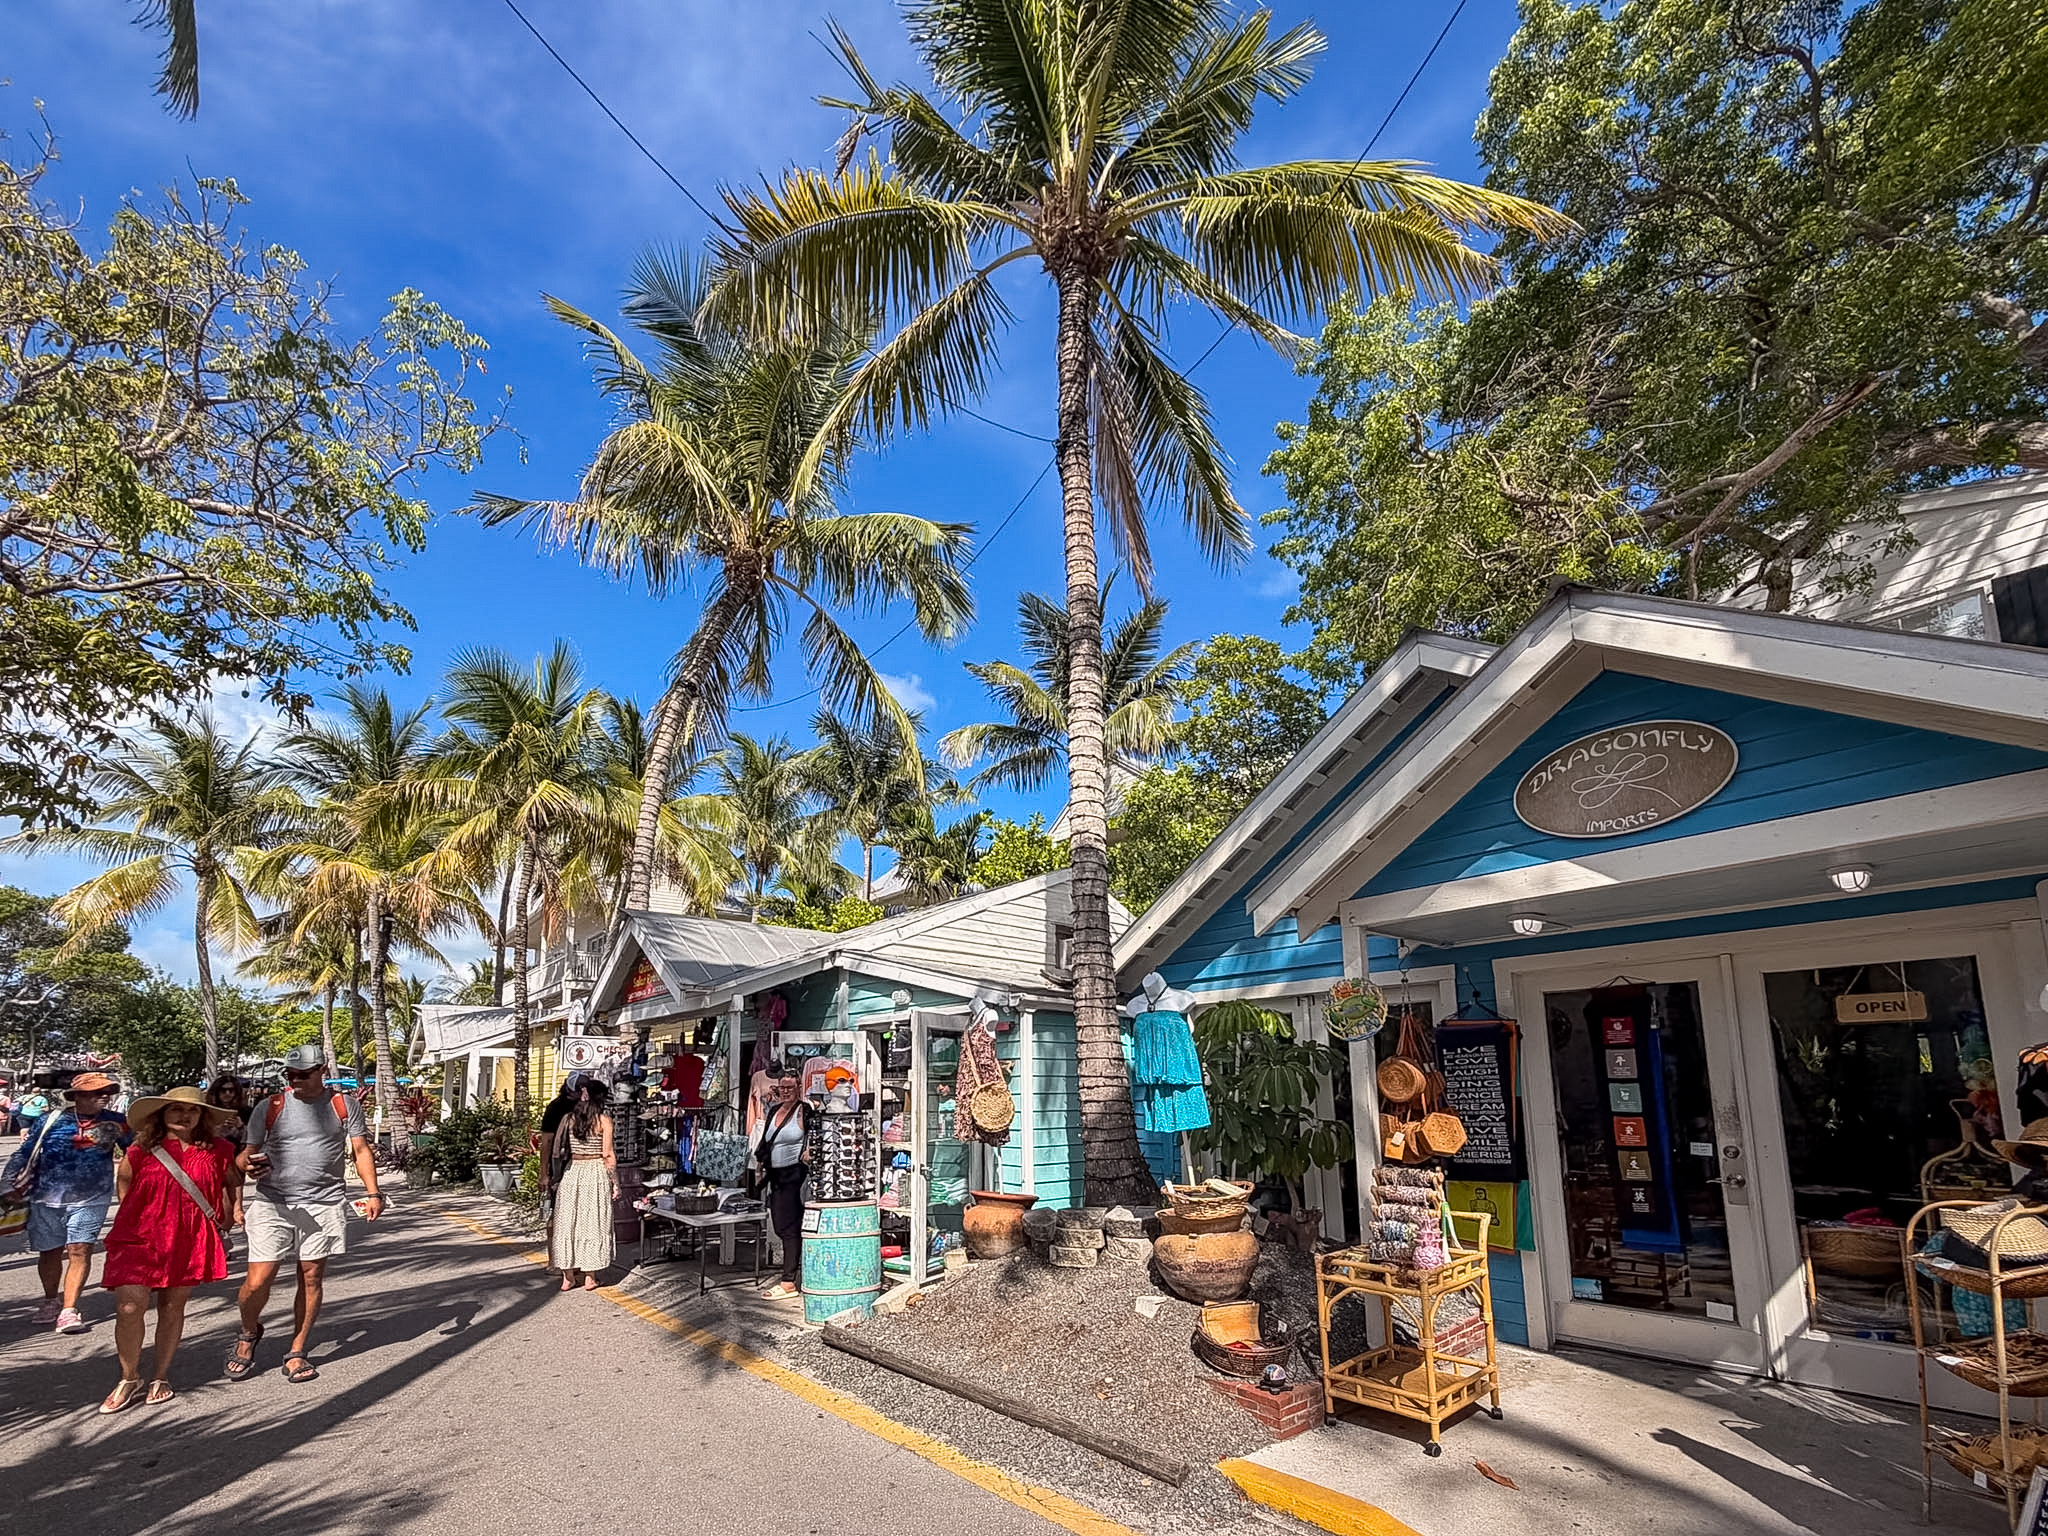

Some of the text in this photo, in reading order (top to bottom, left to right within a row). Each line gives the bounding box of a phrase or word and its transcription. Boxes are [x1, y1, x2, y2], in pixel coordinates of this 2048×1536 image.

[1529, 729, 1715, 794] DRAGONFLY
[1586, 807, 1660, 834] IMPORTS
[1855, 1000, 1907, 1014] OPEN
[1443, 1045, 1496, 1055] LIVE
[1444, 1057, 1497, 1065] LOVE
[1444, 1067, 1499, 1077] LAUGH
[1446, 1079, 1501, 1089] SING
[1446, 1091, 1503, 1100] DANCE
[1464, 1126, 1508, 1135] IVE
[1464, 1138, 1510, 1147] MILE
